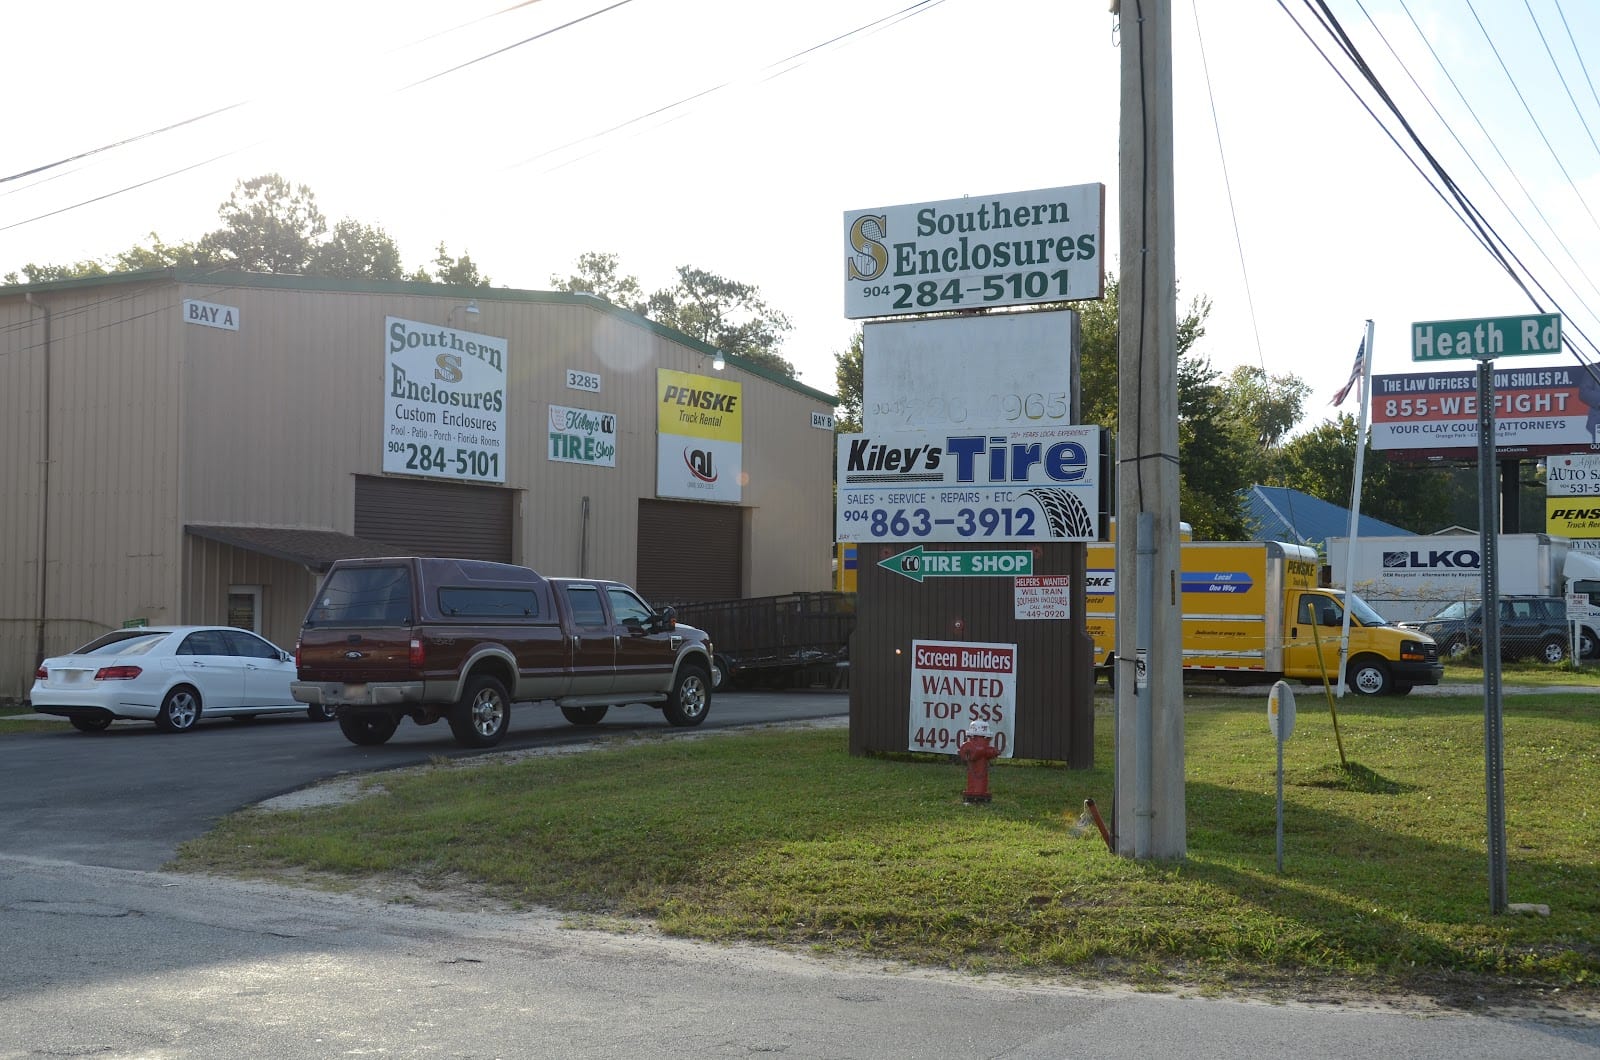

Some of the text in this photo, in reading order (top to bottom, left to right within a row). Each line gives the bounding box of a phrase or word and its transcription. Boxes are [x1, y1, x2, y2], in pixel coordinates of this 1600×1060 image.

[917, 201, 1070, 237] Southern
[893, 233, 1096, 277] Enclosures
[863, 269, 1069, 310] 904 284-5101
[189, 303, 233, 326] BAY A
[390, 322, 503, 373] Southern
[1415, 317, 1559, 357] Heath Rd
[391, 362, 503, 412] Enclosures
[569, 373, 598, 389] 3285
[1511, 372, 1551, 386] SHOLES
[1554, 371, 1573, 385] P.A.
[663, 385, 738, 413] PENSKE
[395, 404, 497, 431] Custom Enclosures
[565, 410, 600, 436] Kiley's
[679, 410, 723, 427] Truck Rental
[813, 415, 832, 427] BAY B
[1390, 424, 1419, 434] YOUR
[1422, 423, 1449, 434] CLAY
[1499, 420, 1566, 431] ATTORNEYS
[390, 424, 500, 447] Pool Patio Porch Florida Rooms
[550, 432, 614, 461] TIRE Shop
[388, 441, 498, 477] 904 284-5101
[847, 439, 942, 473] Kiley's
[946, 435, 1088, 482] Tire
[1549, 467, 1600, 481] AUTO S
[847, 491, 1016, 505] SALES SERVICE REPAIRS ETC.
[843, 507, 1035, 537] 904 863-3912
[1566, 521, 1586, 529] Truck
[921, 555, 1028, 572] TIRE SHOP
[1288, 560, 1315, 577] PENSKE
[1410, 549, 1480, 569] LKQ
[1016, 577, 1068, 587] HELPERS WANTED
[1086, 577, 1112, 587] SKE
[1213, 573, 1233, 581] Local
[1021, 588, 1038, 596] WILL
[1209, 584, 1237, 593] One Way
[1016, 596, 1040, 607] SOUTHERN
[1026, 610, 1065, 618] 449-0920
[917, 648, 1011, 670] Screen Builders
[921, 675, 1004, 698] WANTED
[923, 701, 1003, 724] TOP $$$
[914, 727, 1007, 753] 449-00
